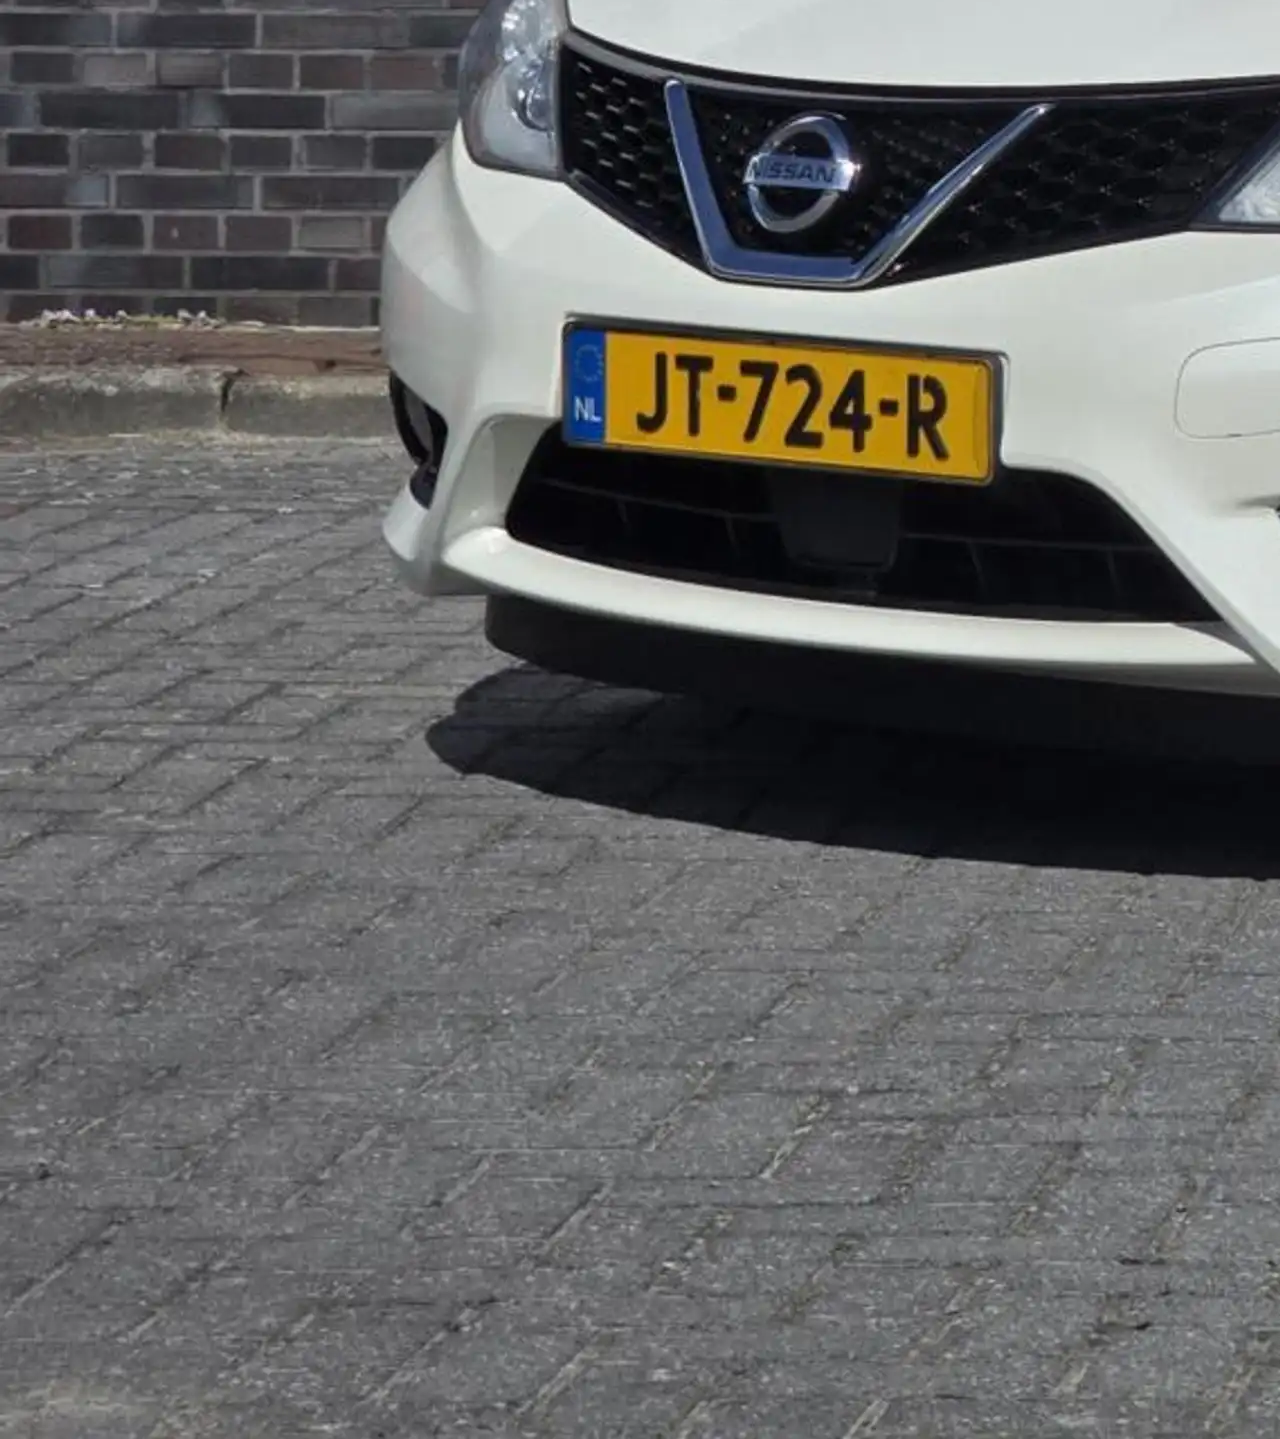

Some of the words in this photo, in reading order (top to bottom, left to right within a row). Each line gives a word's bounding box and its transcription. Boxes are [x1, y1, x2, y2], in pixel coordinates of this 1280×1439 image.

[752, 161, 835, 183] NISSAN
[574, 396, 602, 422] NL
[636, 351, 950, 461] JT-724-R
